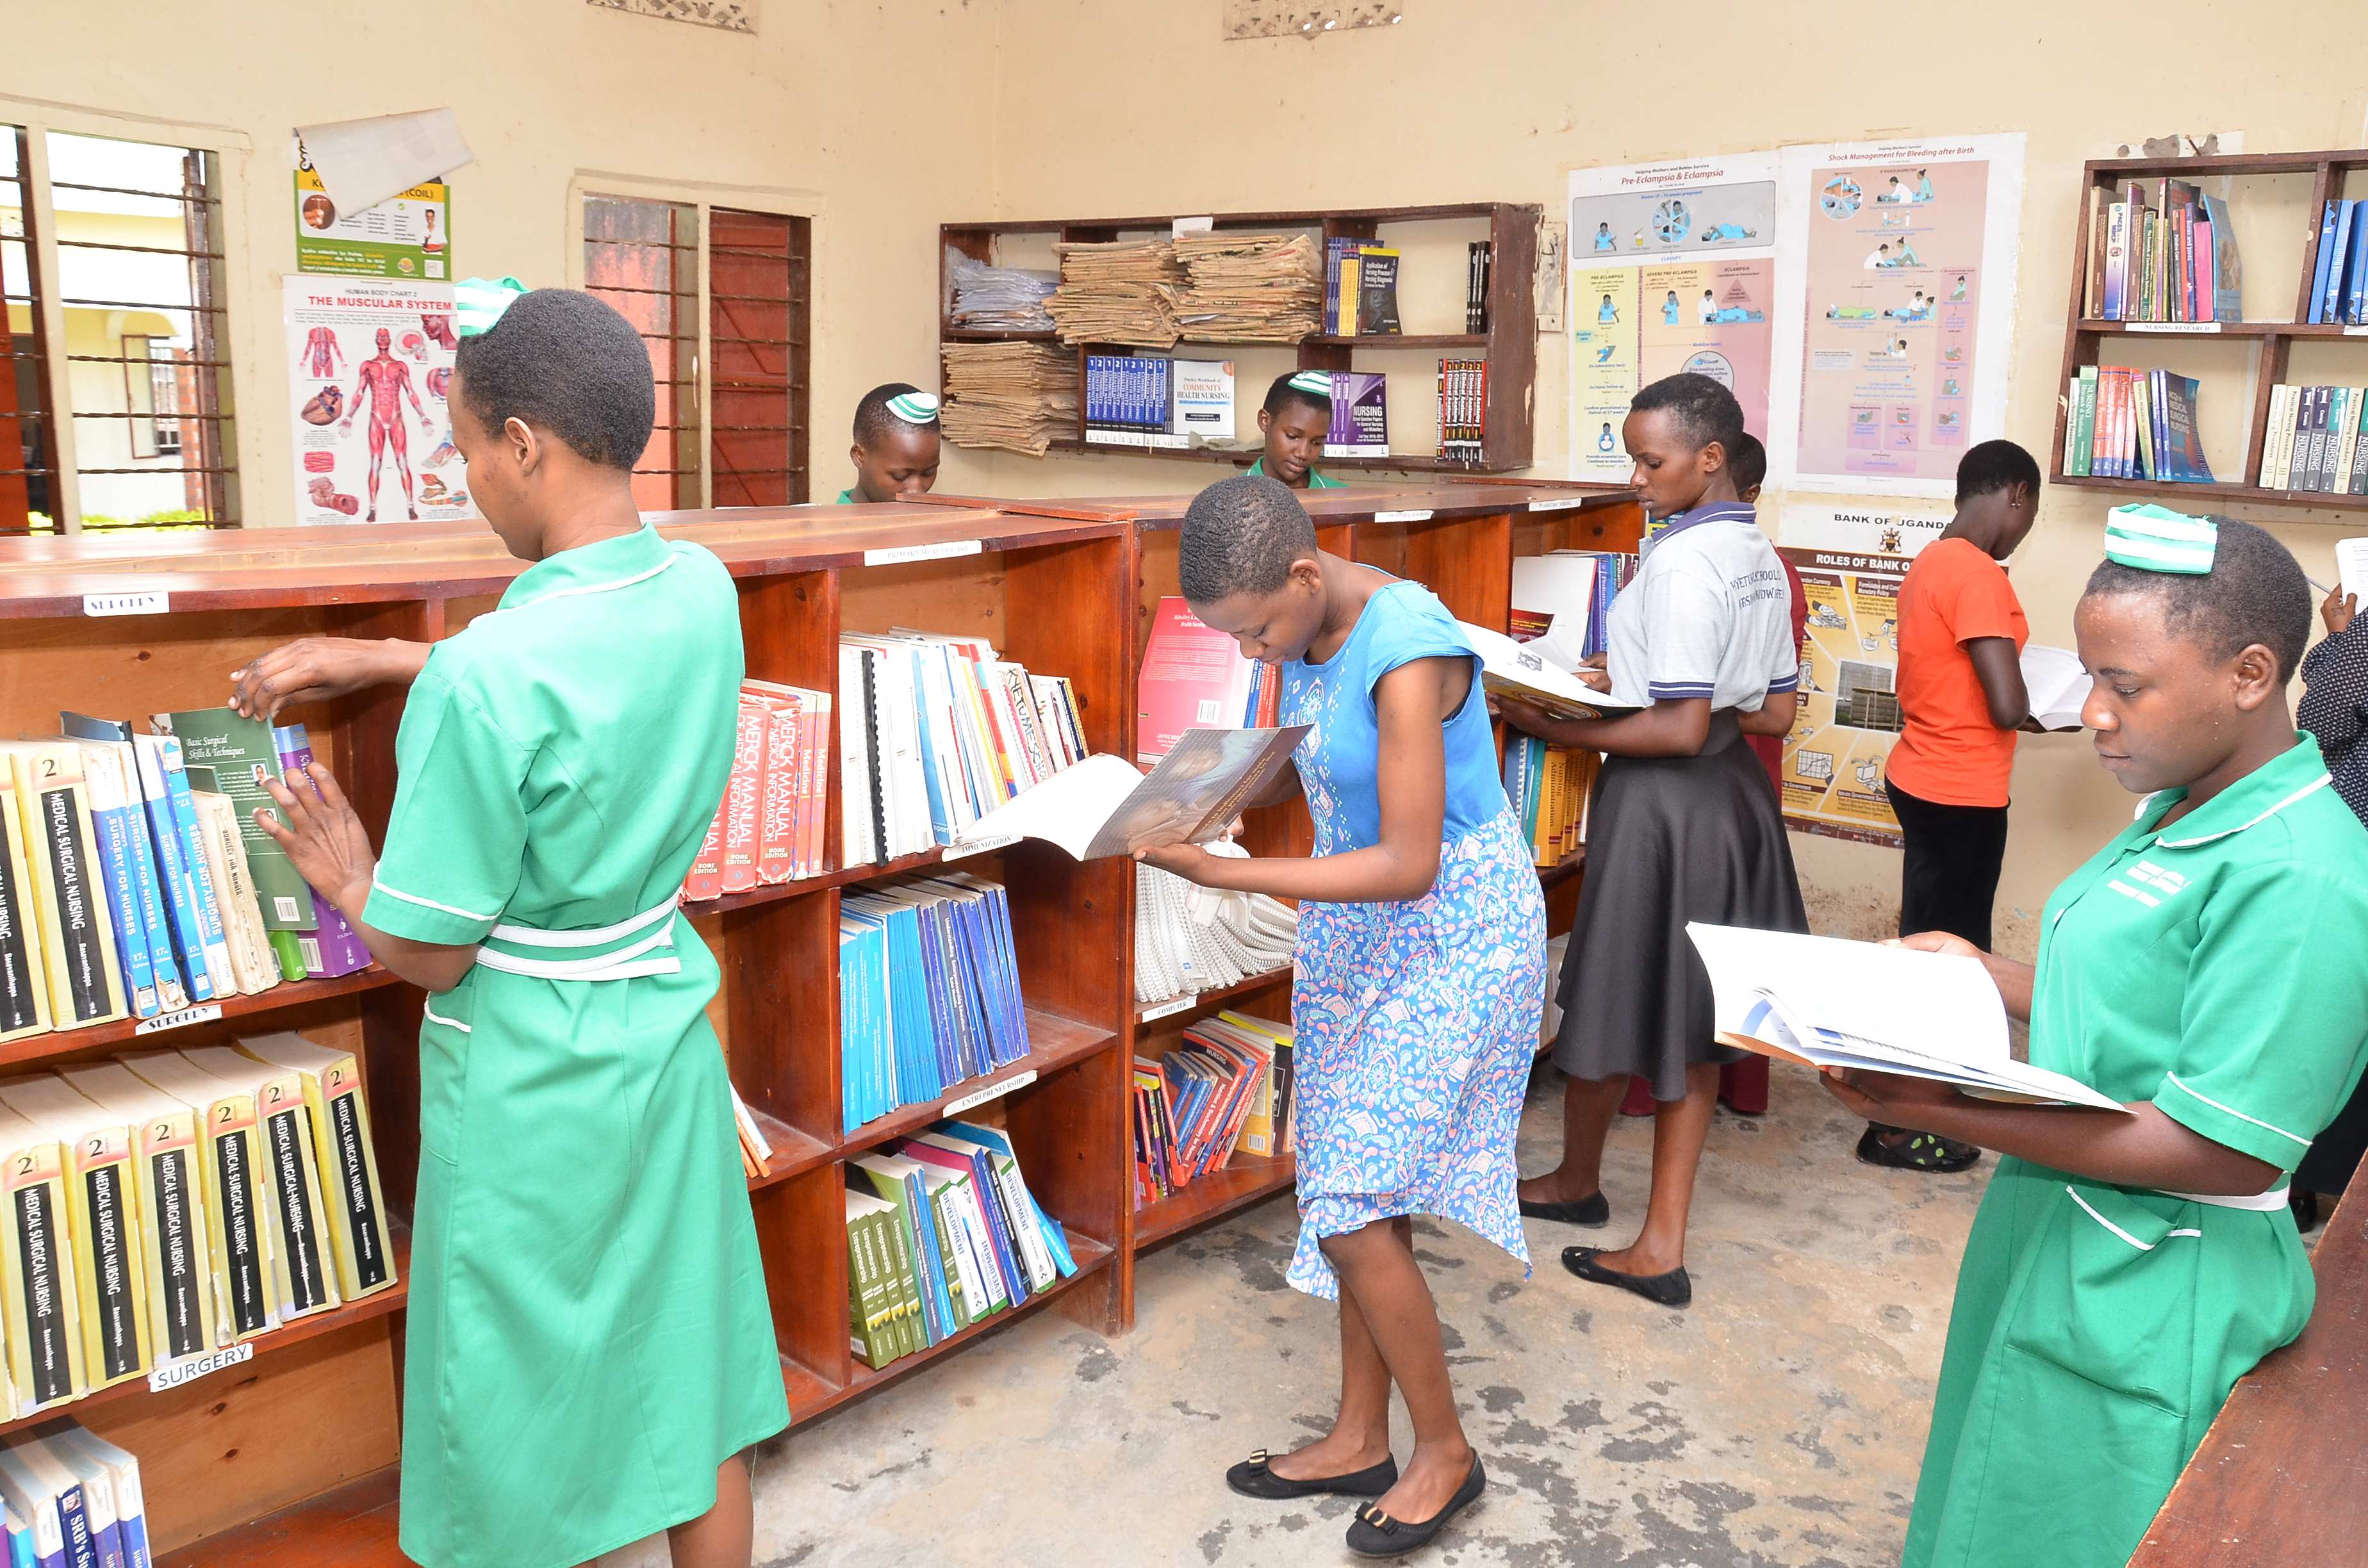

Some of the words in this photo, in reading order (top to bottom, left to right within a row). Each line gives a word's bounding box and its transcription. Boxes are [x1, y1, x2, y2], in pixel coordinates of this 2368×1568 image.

[1849, 152, 1895, 161] Management
[1907, 149, 1937, 158] Bleeding
[405, 188, 434, 199] (COIL)
[1621, 173, 1675, 185] Pre-Eclampsia
[1684, 168, 1723, 180] Eclampsia
[308, 296, 333, 306] THE
[336, 298, 403, 309] MUSCULAR
[406, 300, 452, 311] SYSTEM
[1177, 391, 1200, 399] HEALTH
[1201, 391, 1230, 400] NURSING
[1353, 405, 1383, 416] NURSING
[2304, 391, 2312, 405] 1
[2319, 389, 2328, 404] 1
[2295, 435, 2307, 473] NURSING
[2310, 434, 2323, 471] NURSING
[2325, 435, 2338, 473] NURSING
[1834, 514, 1870, 524] BANK
[1816, 553, 1850, 566] ROLES
[1852, 558, 1867, 568] OF
[1868, 559, 1899, 571] BANK
[1901, 561, 1912, 572] O
[1857, 588, 1877, 596] Monetary
[185, 736, 202, 747] Basic
[202, 733, 229, 746] Surgical
[188, 746, 204, 758] Skills
[211, 746, 245, 757] Techniques
[730, 732, 744, 775] MEDICAL
[743, 715, 762, 772] MERCK
[768, 727, 780, 770] MEDICAL
[779, 710, 800, 767] MERCK
[42, 760, 58, 778] 2
[801, 749, 811, 794] Medicine
[815, 747, 826, 794] Medicine
[1557, 762, 1565, 797] Nursing
[727, 778, 742, 849] INFORMATION
[737, 775, 757, 848] MANUAL
[764, 772, 778, 843] INFORMATION
[774, 771, 792, 842] MANUAL
[1549, 762, 1558, 827] Administration
[51, 793, 70, 838] MEDICAL
[109, 818, 124, 868] SURGERY
[131, 813, 145, 863] SURGERY
[188, 822, 204, 865] NURSES
[961, 835, 1012, 854] IMMUNIZATION
[57, 837, 78, 885] SURGICAL
[138, 865, 149, 888] FOR
[197, 865, 211, 888] FOR
[117, 870, 128, 894] FOR
[66, 885, 86, 931] NURSING
[120, 892, 136, 936] NURSES
[142, 886, 158, 932] NURSES
[202, 887, 223, 936] SURGERY
[944, 917, 954, 958] Understanding
[951, 960, 962, 1005] Entrepreneurship
[148, 1008, 215, 1031] SURGERY
[1158, 1002, 1187, 1016] COMPUTER
[1206, 1047, 1227, 1066] NURSING
[268, 1086, 281, 1104] 2
[331, 1070, 341, 1086] 2
[961, 1077, 1025, 1108] ENTREPRENEURSHIP
[1213, 1083, 1227, 1104] Nutrition
[156, 1123, 170, 1142] 2
[219, 1106, 232, 1123] 2
[275, 1115, 292, 1153] MEDICAL
[337, 1098, 352, 1136] MEDICAL
[1195, 1108, 1215, 1138] Biochemistry
[18, 1157, 33, 1176] 2
[89, 1139, 103, 1156] 2
[224, 1135, 240, 1174] MEDICAL
[343, 1134, 359, 1175] SURGICAL
[1185, 1145, 1197, 1161] Nurses
[95, 1170, 113, 1211] MEDICAL
[161, 1154, 178, 1194] MEDICAL
[280, 1152, 297, 1195] SURGICAL
[350, 1173, 366, 1213] NURSING
[24, 1189, 42, 1230] MEDICAL
[228, 1173, 244, 1216] SURGICAL
[288, 1193, 305, 1233] NURSING
[1005, 1172, 1030, 1232] DEVELOPMENT
[99, 1209, 116, 1255] SURGICAL
[165, 1193, 182, 1237] SURGICAL
[935, 1202, 949, 1252] Entrepreneurship
[942, 1193, 965, 1255] DEVELOPMENT
[29, 1230, 49, 1276] SURGICAL
[233, 1216, 249, 1255] NURSING
[862, 1227, 878, 1280] Entrepreneurship
[875, 1222, 891, 1274] Entrepreneurship
[893, 1218, 908, 1270] Entrepreneurship
[910, 1190, 919, 1230] Understanding
[917, 1230, 928, 1275] Entrepreneurship
[925, 1273, 933, 1300] Education
[104, 1254, 121, 1296] NURSING
[169, 1236, 186, 1277] NURSING
[852, 1231, 867, 1284] Entrepreneurship
[981, 1240, 1004, 1299] DEVELOPMENT
[35, 1274, 52, 1318] NURSING
[157, 1344, 249, 1389] SURGERY
[70, 1514, 86, 1553] SRB's
